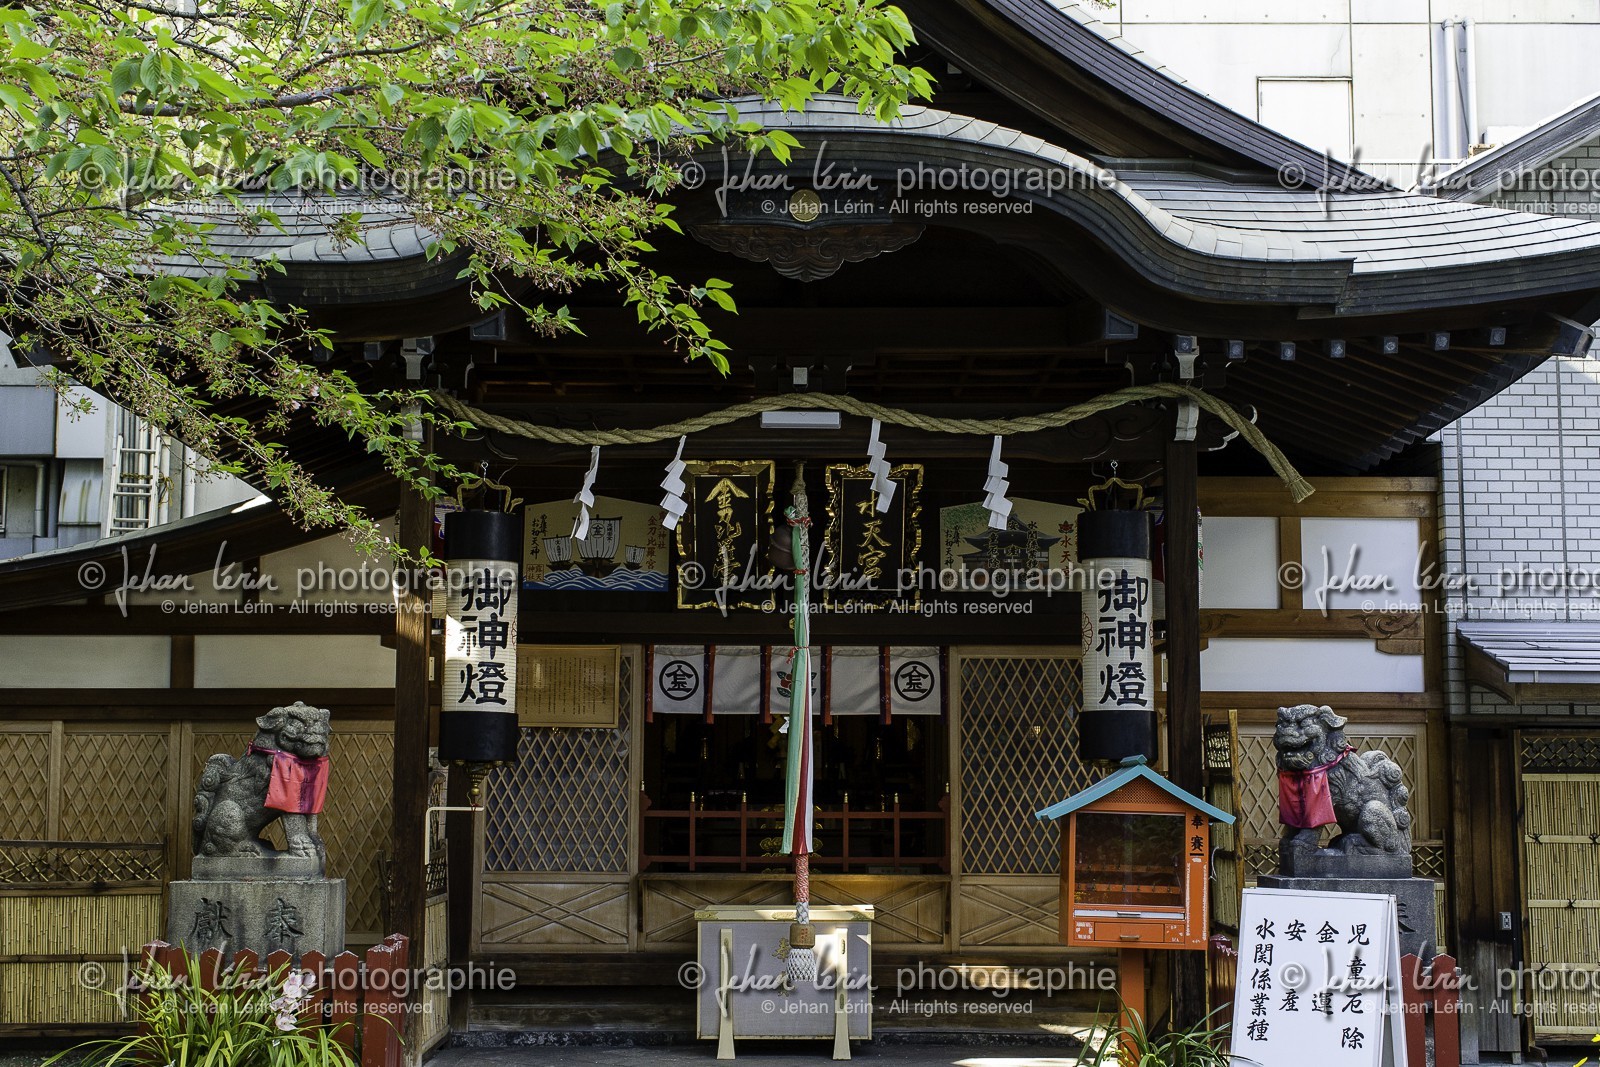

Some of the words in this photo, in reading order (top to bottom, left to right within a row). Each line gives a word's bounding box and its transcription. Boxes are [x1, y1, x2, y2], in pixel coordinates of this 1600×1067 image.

[529, 518, 540, 560] お初天神
[645, 515, 658, 570] 金刀比羅宮
[987, 532, 1001, 569] 童厄除
[457, 568, 511, 706] 御神燈
[1095, 568, 1149, 707] 御神燈
[1246, 917, 1276, 1042] 水関係業種
[1279, 919, 1307, 1012] 安産
[1311, 920, 1340, 1016] 金運
[1341, 923, 1370, 1050] 児童厄除
